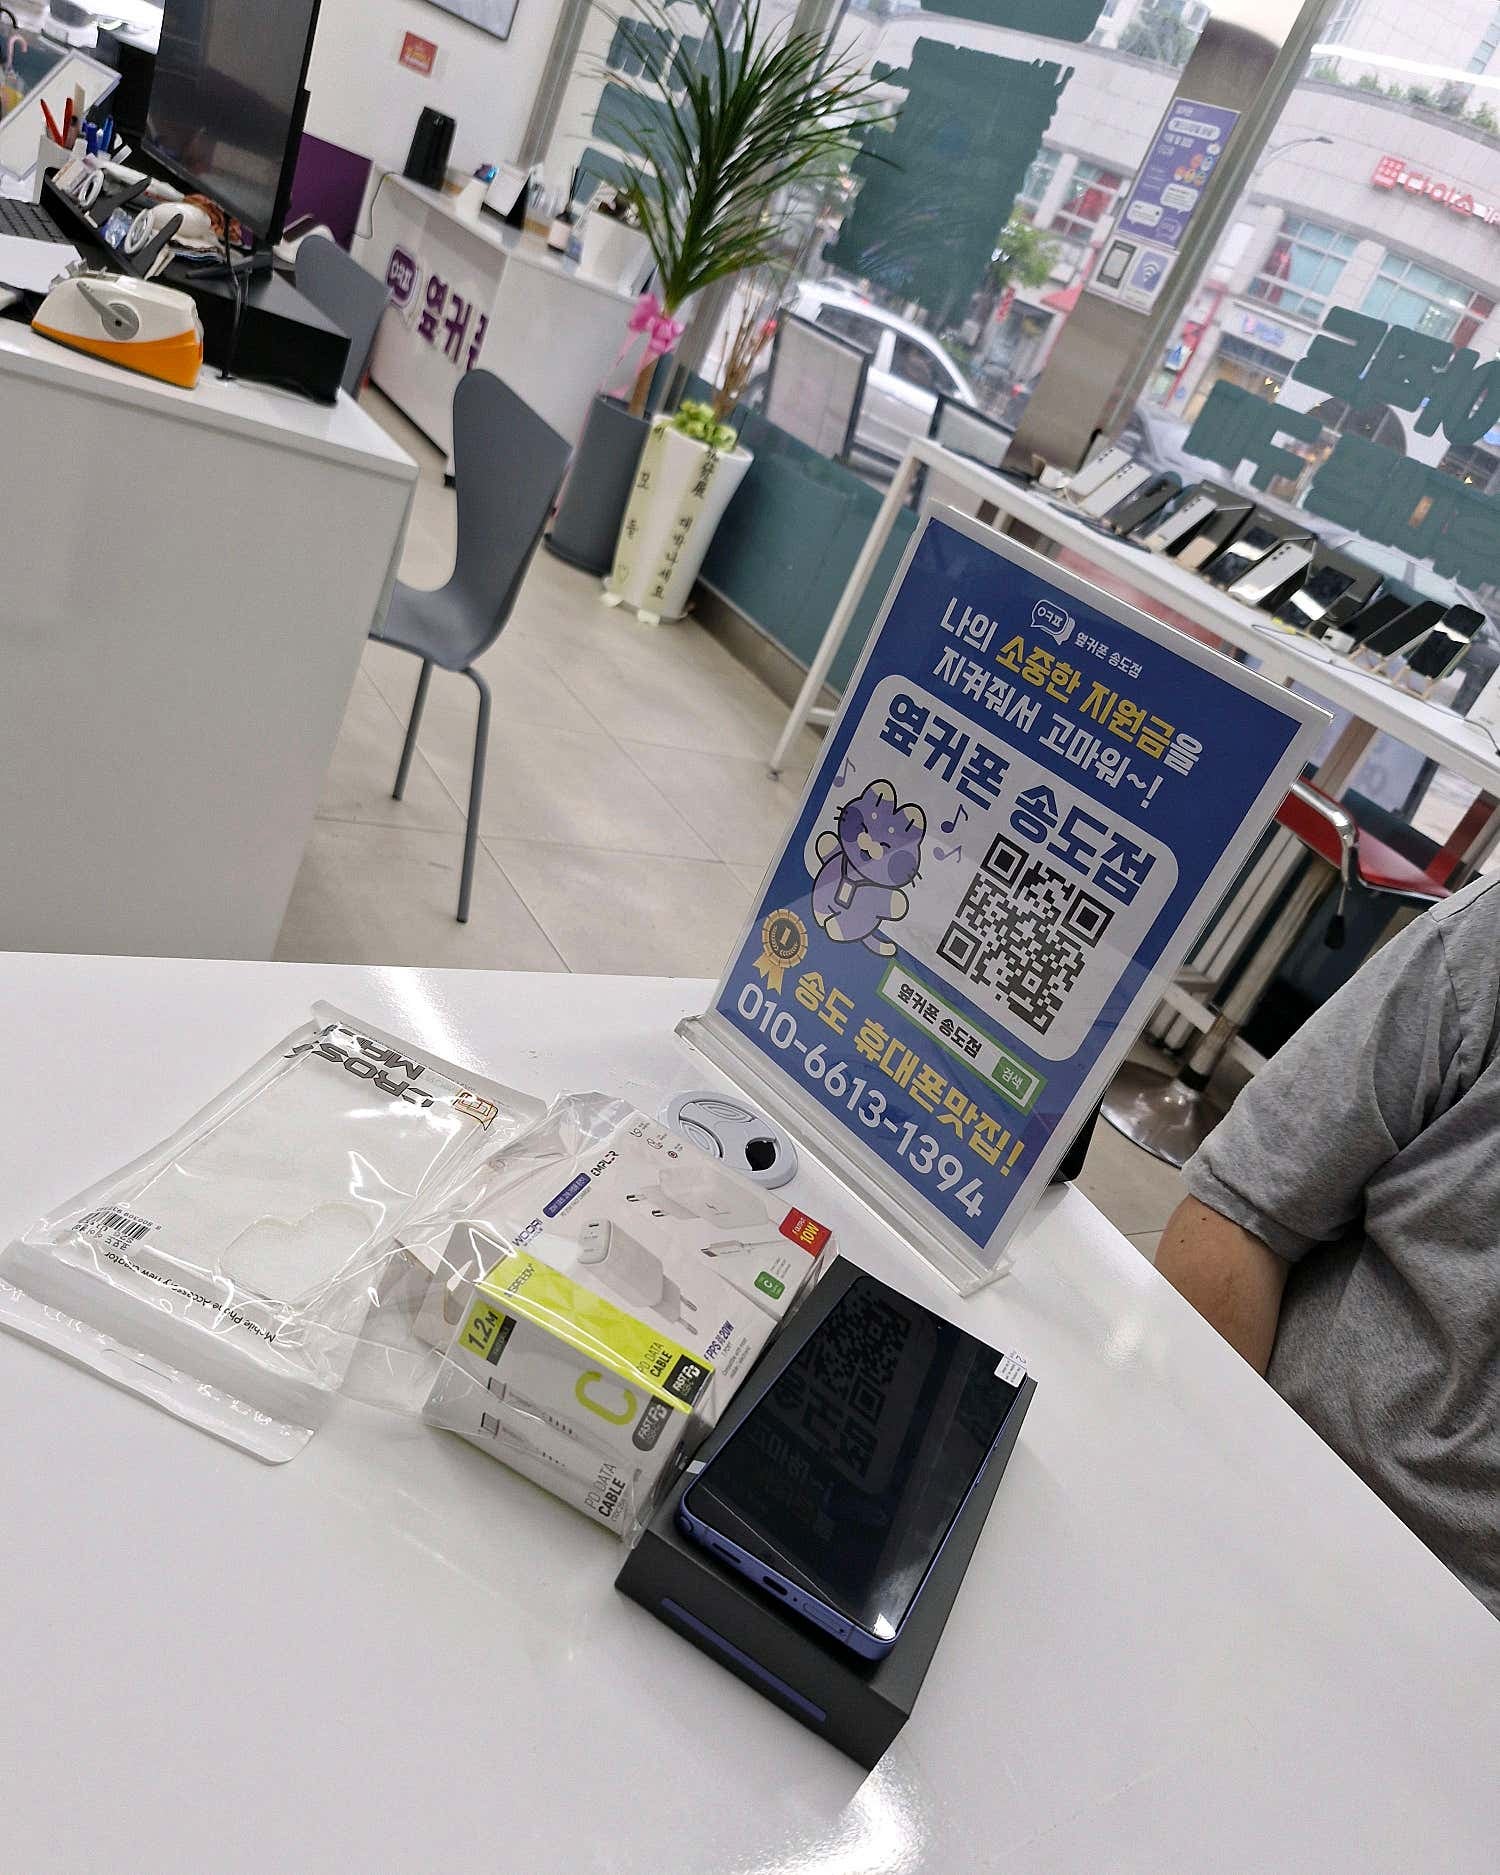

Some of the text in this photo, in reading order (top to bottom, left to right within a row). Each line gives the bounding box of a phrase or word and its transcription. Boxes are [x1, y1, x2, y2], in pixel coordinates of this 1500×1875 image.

[1074, 632, 1143, 679] 옆커폰 송도점
[940, 596, 1203, 777] 나의 소중한 지원금을
[933, 645, 1164, 809] 지켜줘서 고마워~!
[879, 693, 1157, 907] 옆커폰 송도점
[897, 983, 984, 1060] 옆커폰 송도점
[793, 970, 1026, 1177] 송도 휴대폰맛집!
[1002, 1065, 1025, 1090] 검색
[736, 983, 987, 1220] 010-6613-1394
[800, 1222, 820, 1245] 10W
[720, 1320, 735, 1340] 20W
[649, 1351, 673, 1378] CABLE
[672, 1371, 690, 1392] FAST
[575, 1370, 638, 1426] C
[637, 1415, 655, 1441] FAST
[584, 1463, 617, 1511] PD DATA
[598, 1477, 627, 1518] CABLE
